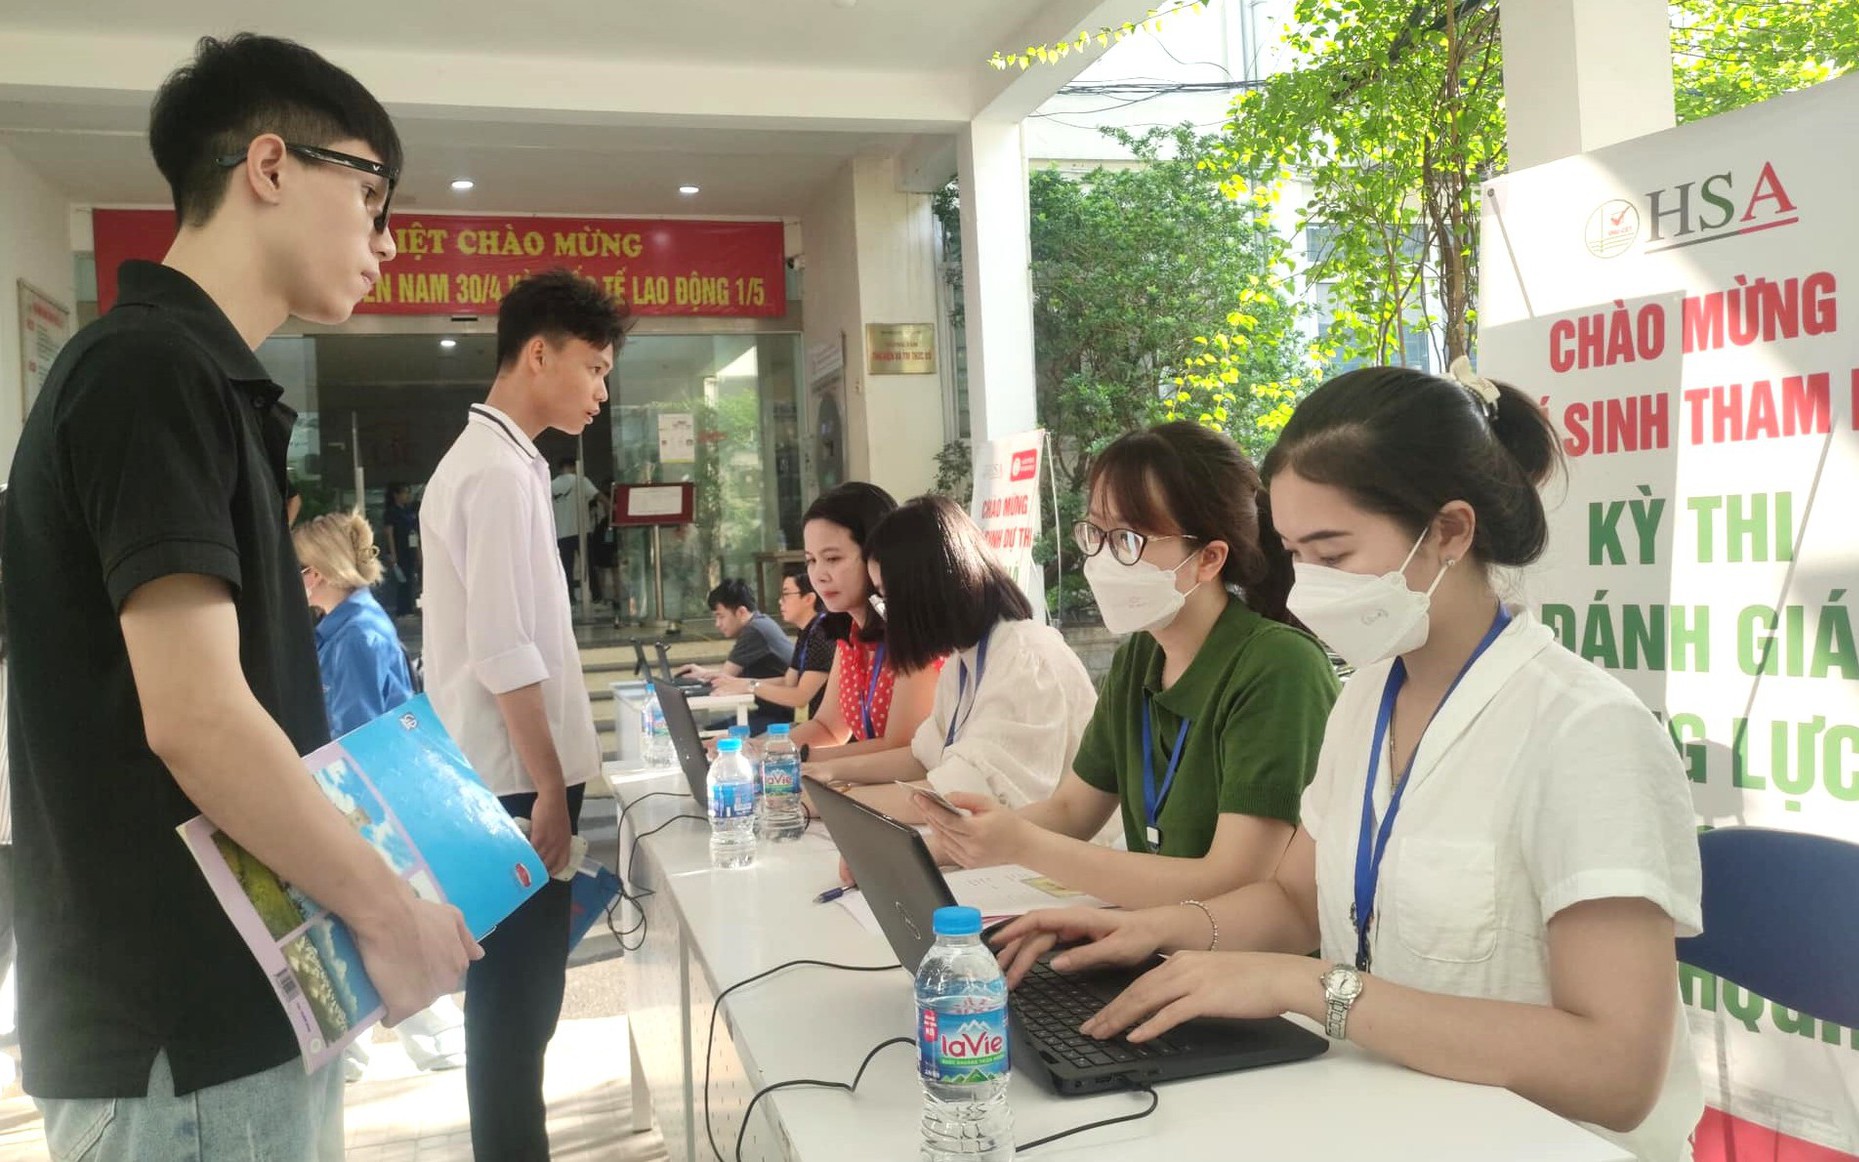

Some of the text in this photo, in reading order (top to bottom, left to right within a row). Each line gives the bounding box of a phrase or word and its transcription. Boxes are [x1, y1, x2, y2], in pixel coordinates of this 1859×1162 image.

[394, 222, 643, 261] IỆT CHÀO MỪNG
[1644, 161, 1798, 243] HSA
[398, 273, 450, 304] NAM
[456, 273, 503, 304] 30/4
[632, 276, 670, 305] LAO
[675, 270, 730, 312] ĐỘNG
[736, 276, 765, 307] 1/5
[1549, 271, 1838, 374] CHÀO MỪNG
[1563, 392, 1669, 458] SINH
[1684, 371, 1832, 446] THAM
[1588, 484, 1794, 566] KỲ THI
[1541, 588, 1859, 681] ĐÁNH GIÁ
[766, 774, 792, 785] aVie
[1732, 715, 1859, 812] LỰC
[941, 1031, 1003, 1058] laVie
